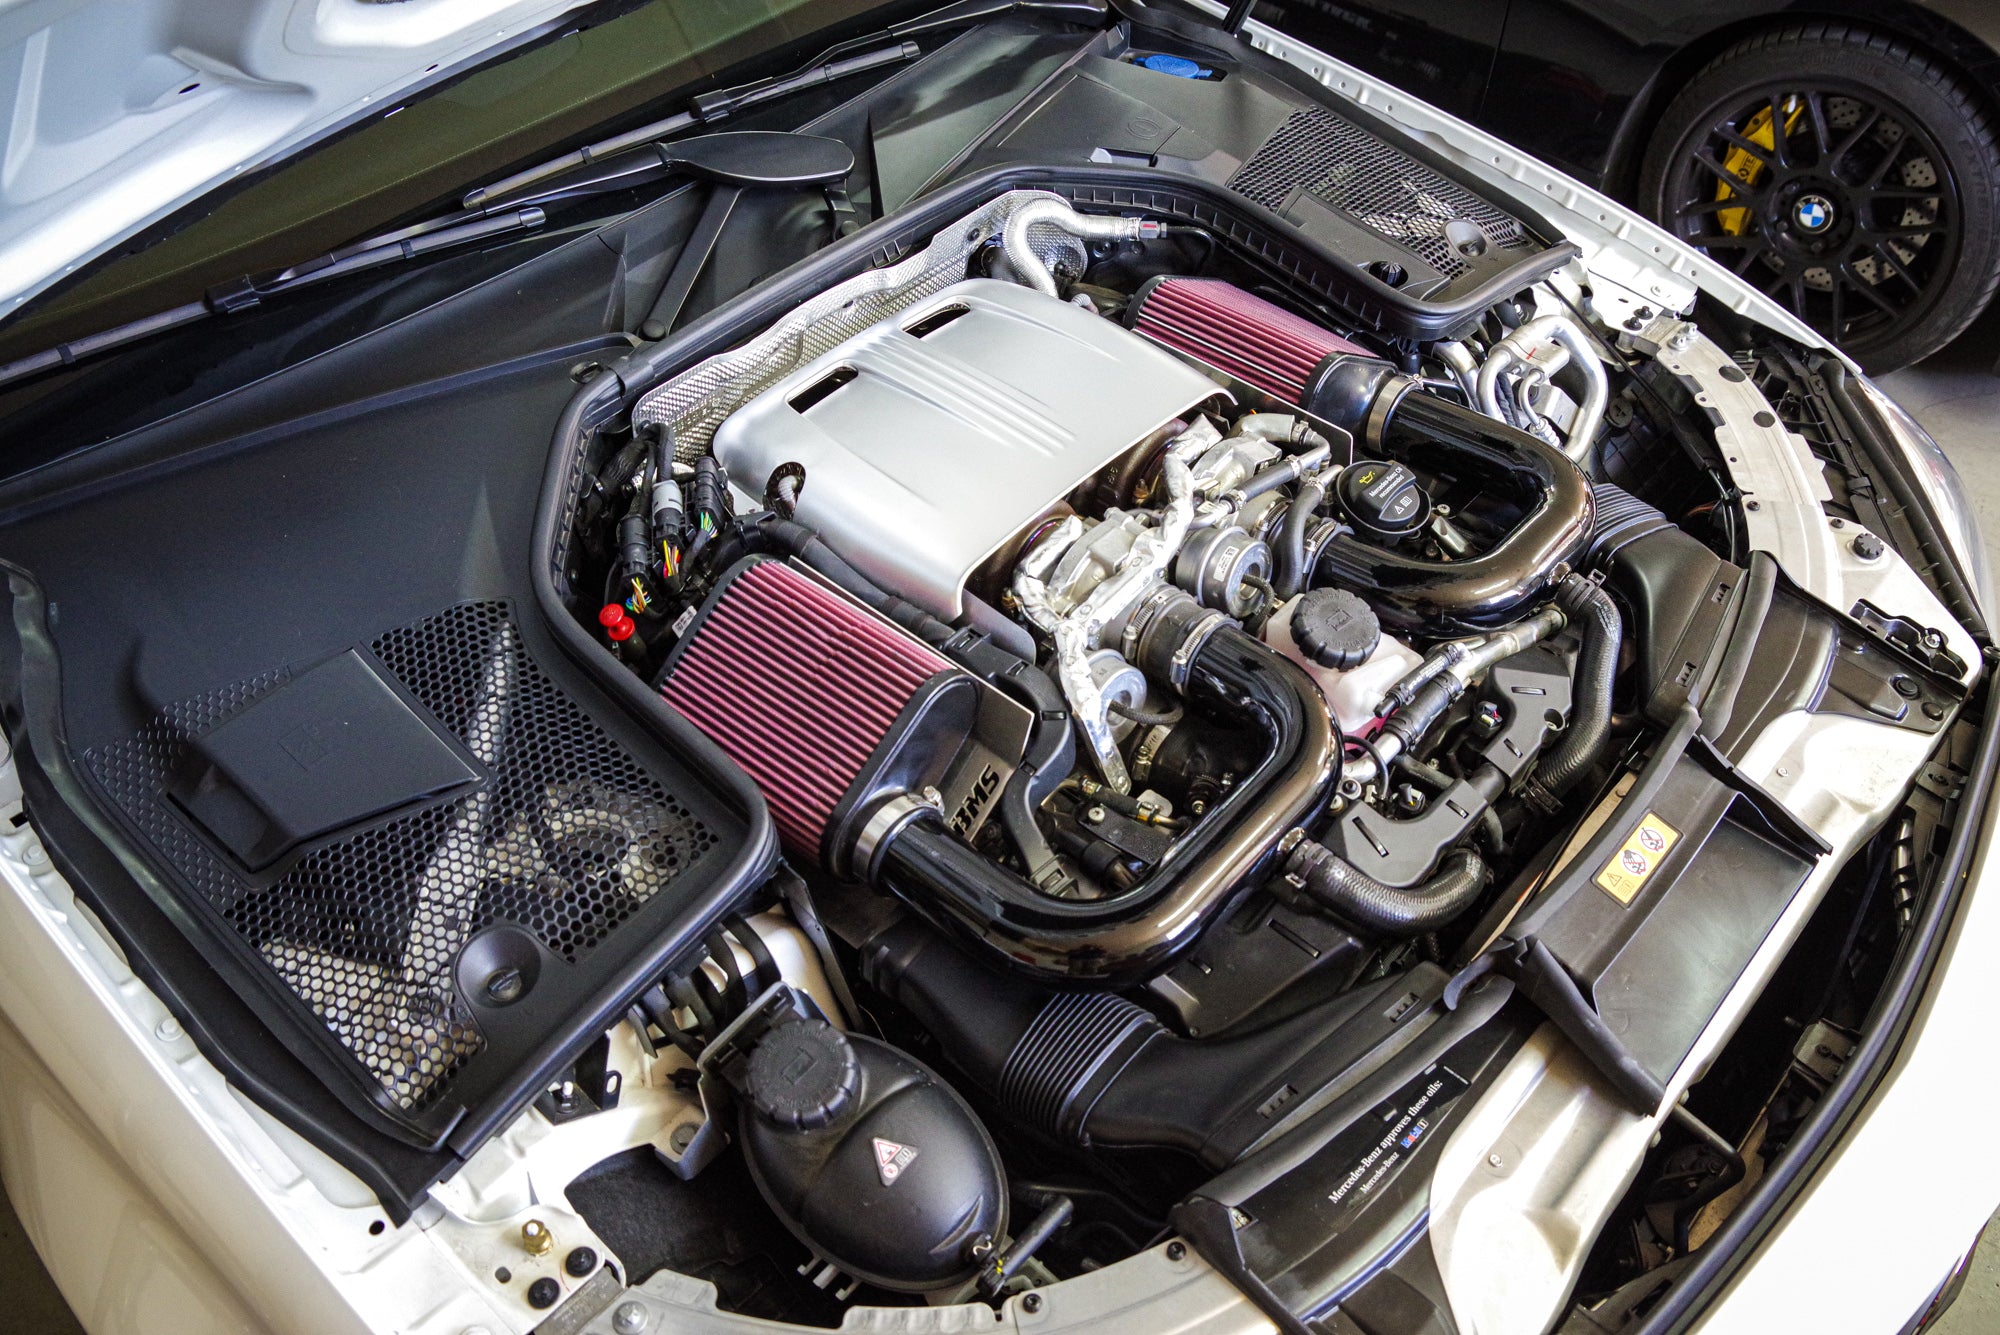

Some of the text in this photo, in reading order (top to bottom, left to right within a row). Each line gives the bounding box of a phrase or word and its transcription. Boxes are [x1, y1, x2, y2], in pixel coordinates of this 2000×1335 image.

[1369, 471, 1398, 497] Mercedes-Benz
[1327, 1080, 1443, 1204] Mercedes-Benz approves these oils:
[1359, 1151, 1400, 1194] Mercedes-Benz
